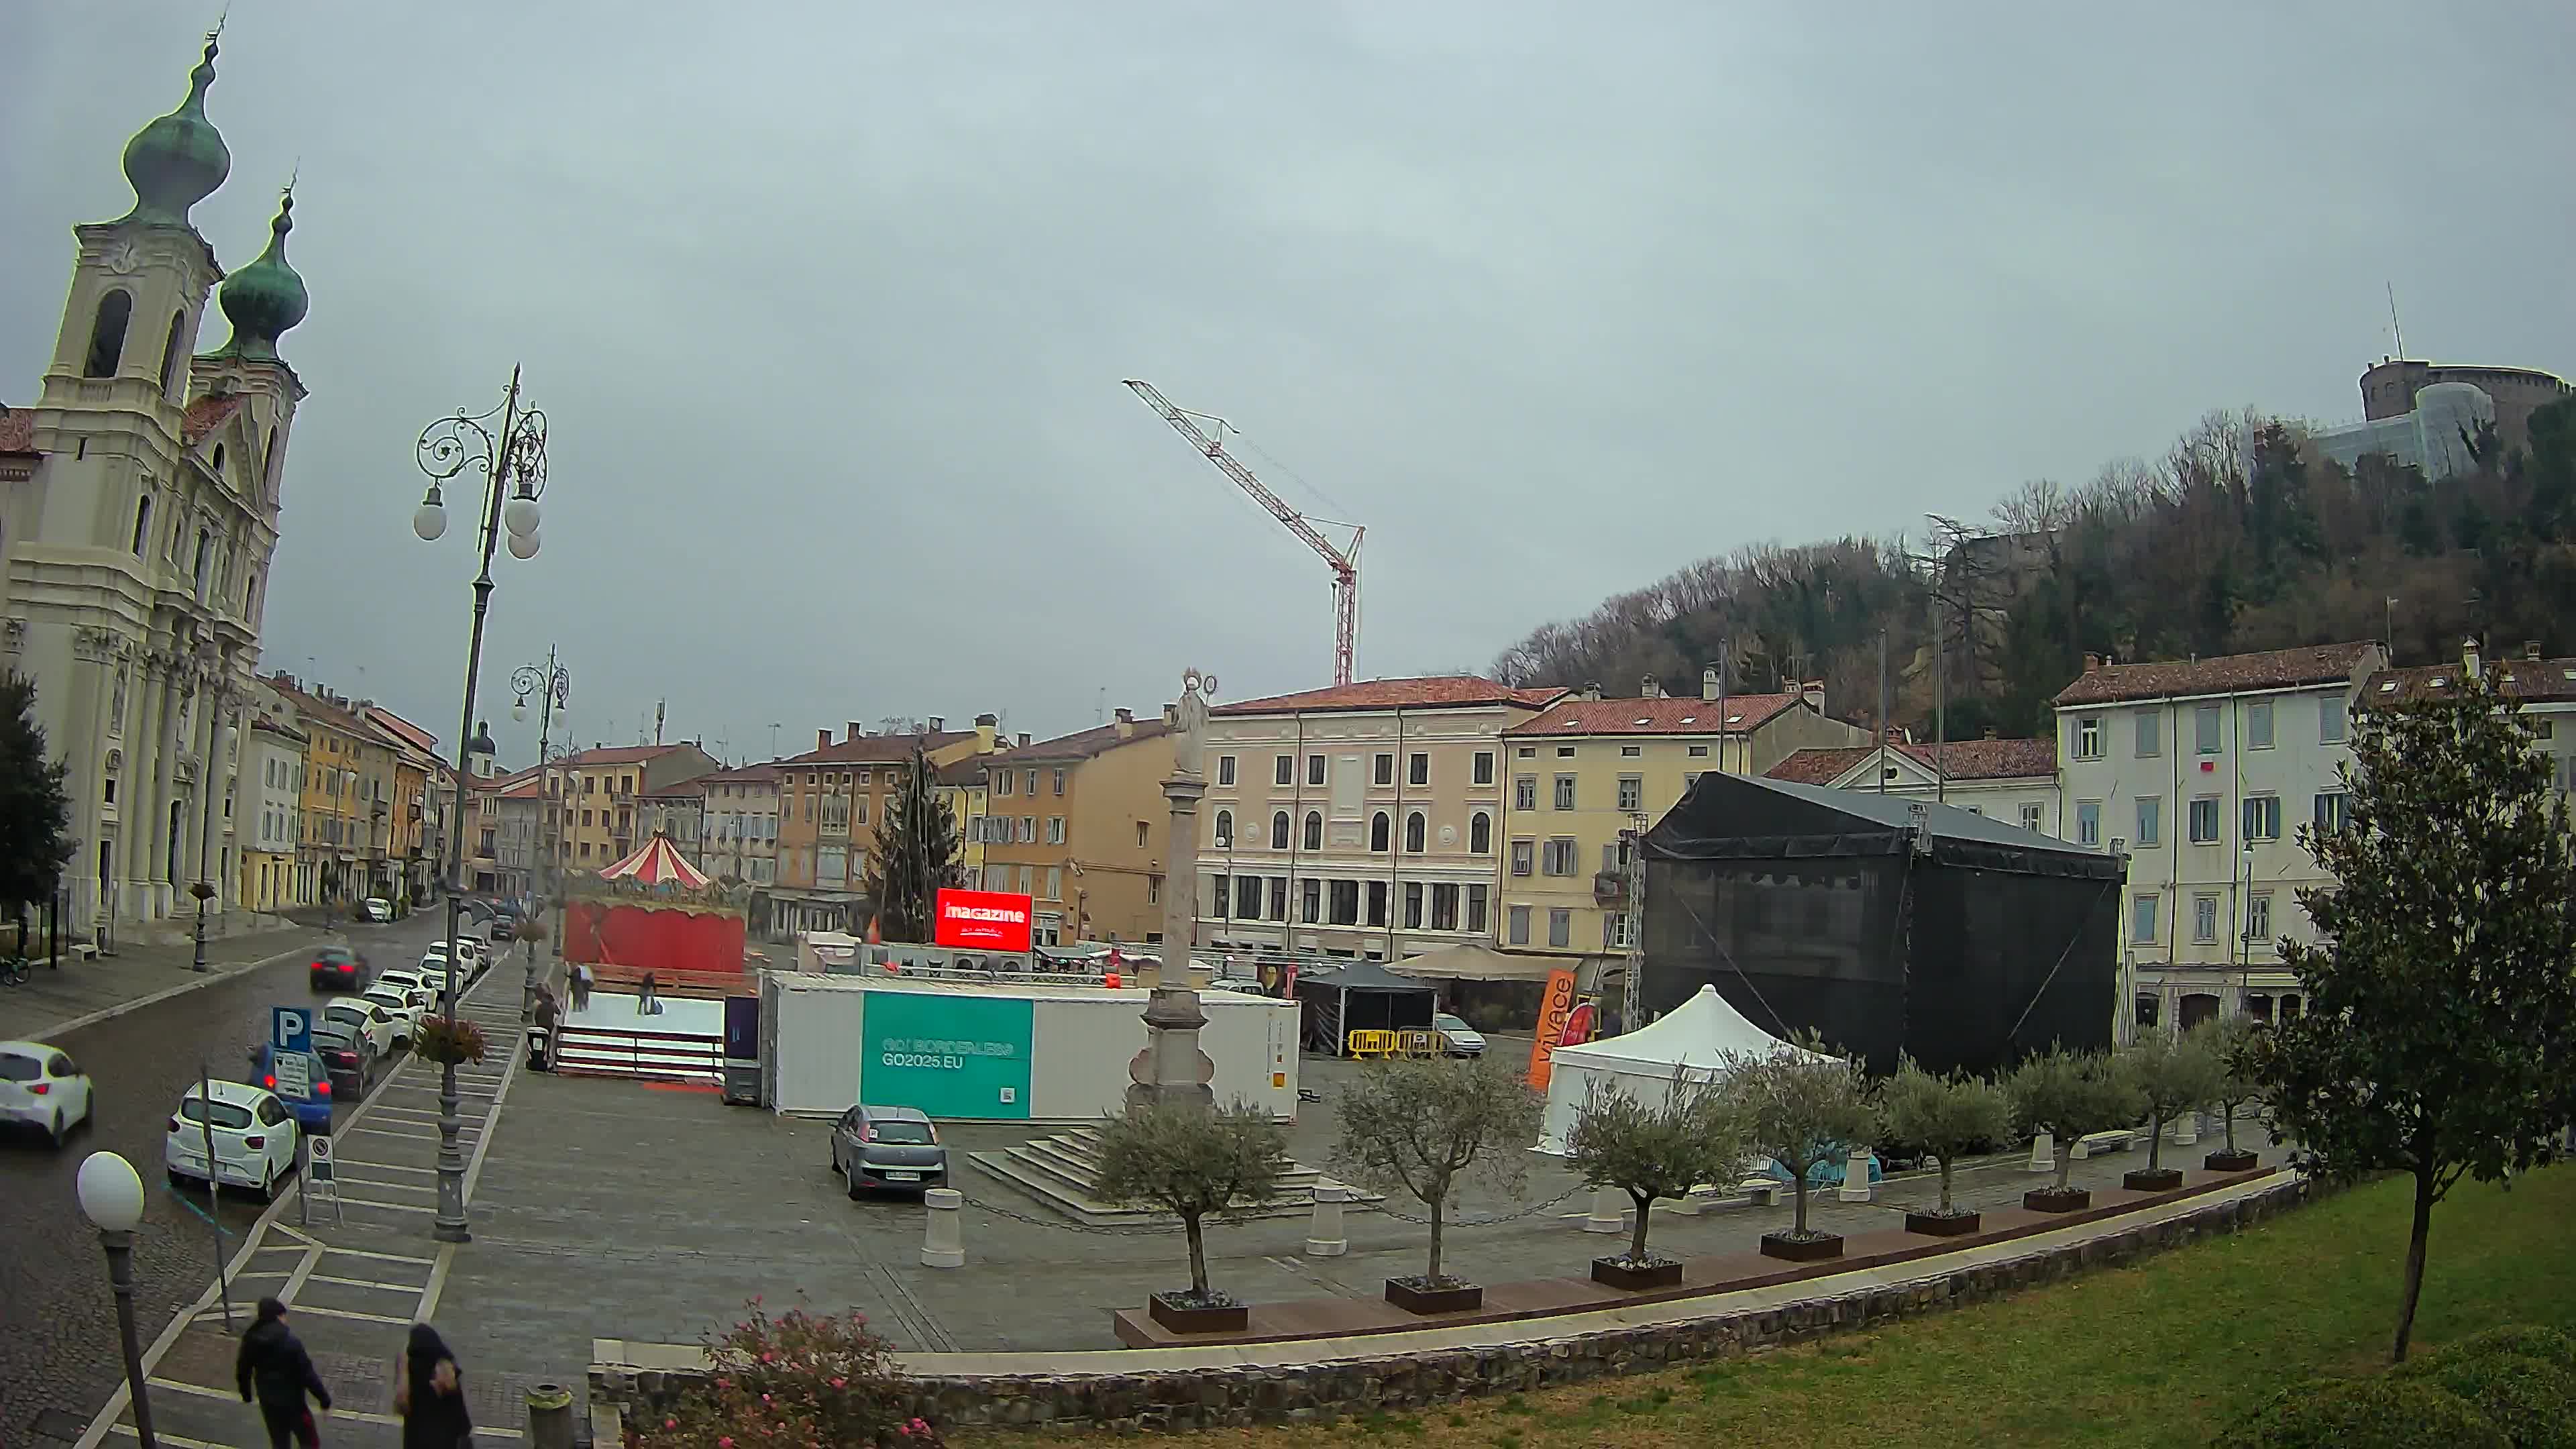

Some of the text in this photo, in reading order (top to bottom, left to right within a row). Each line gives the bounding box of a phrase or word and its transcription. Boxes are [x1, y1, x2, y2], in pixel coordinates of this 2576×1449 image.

[279, 1011, 304, 1047] P
[1538, 977, 1571, 1063] vivace
[882, 1053, 964, 1069] GO2025.EU
